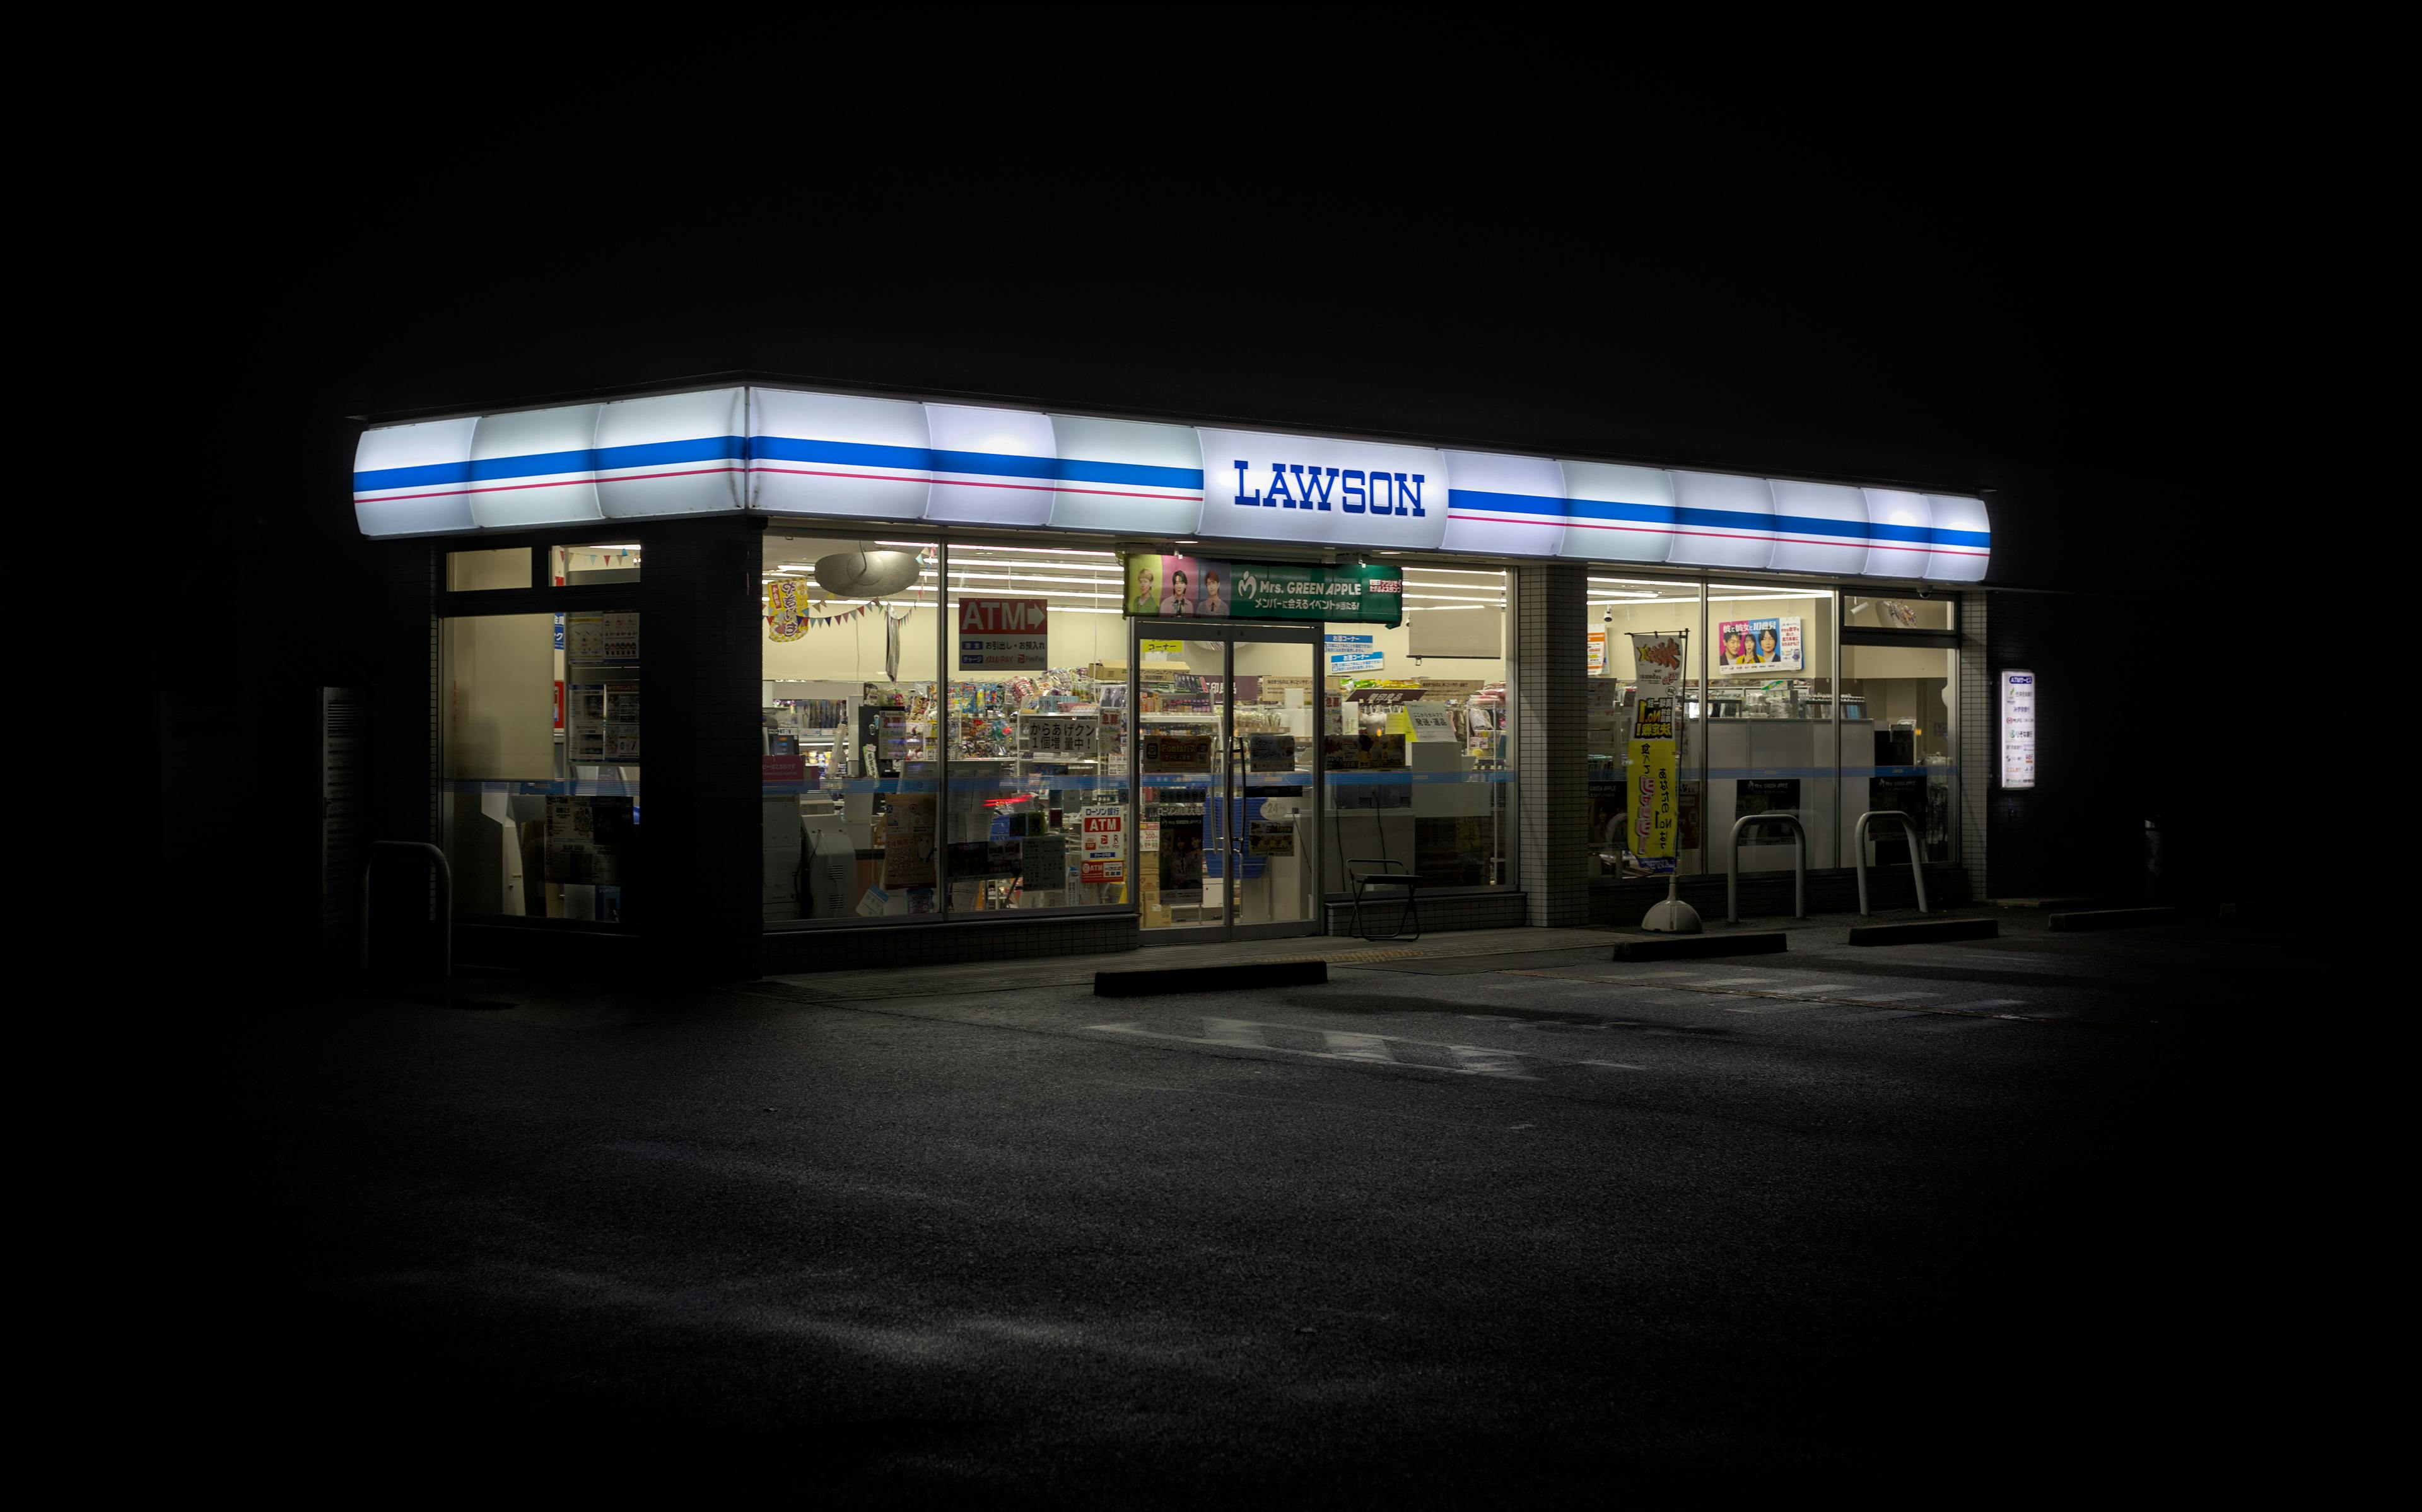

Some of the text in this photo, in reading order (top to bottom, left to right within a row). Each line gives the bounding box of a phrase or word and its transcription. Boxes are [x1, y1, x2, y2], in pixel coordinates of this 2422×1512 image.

[1234, 460, 1425, 517] LAWSON
[1260, 580, 1362, 595] Mrs. GREEN APPLE
[961, 602, 1025, 630] ATM
[1030, 723, 1095, 736] からあげクン
[1033, 736, 1091, 750] 1個増量中!
[1085, 808, 1120, 816] ローソン銀行
[1267, 803, 1278, 813] 24
[1089, 818, 1116, 831] ATM
